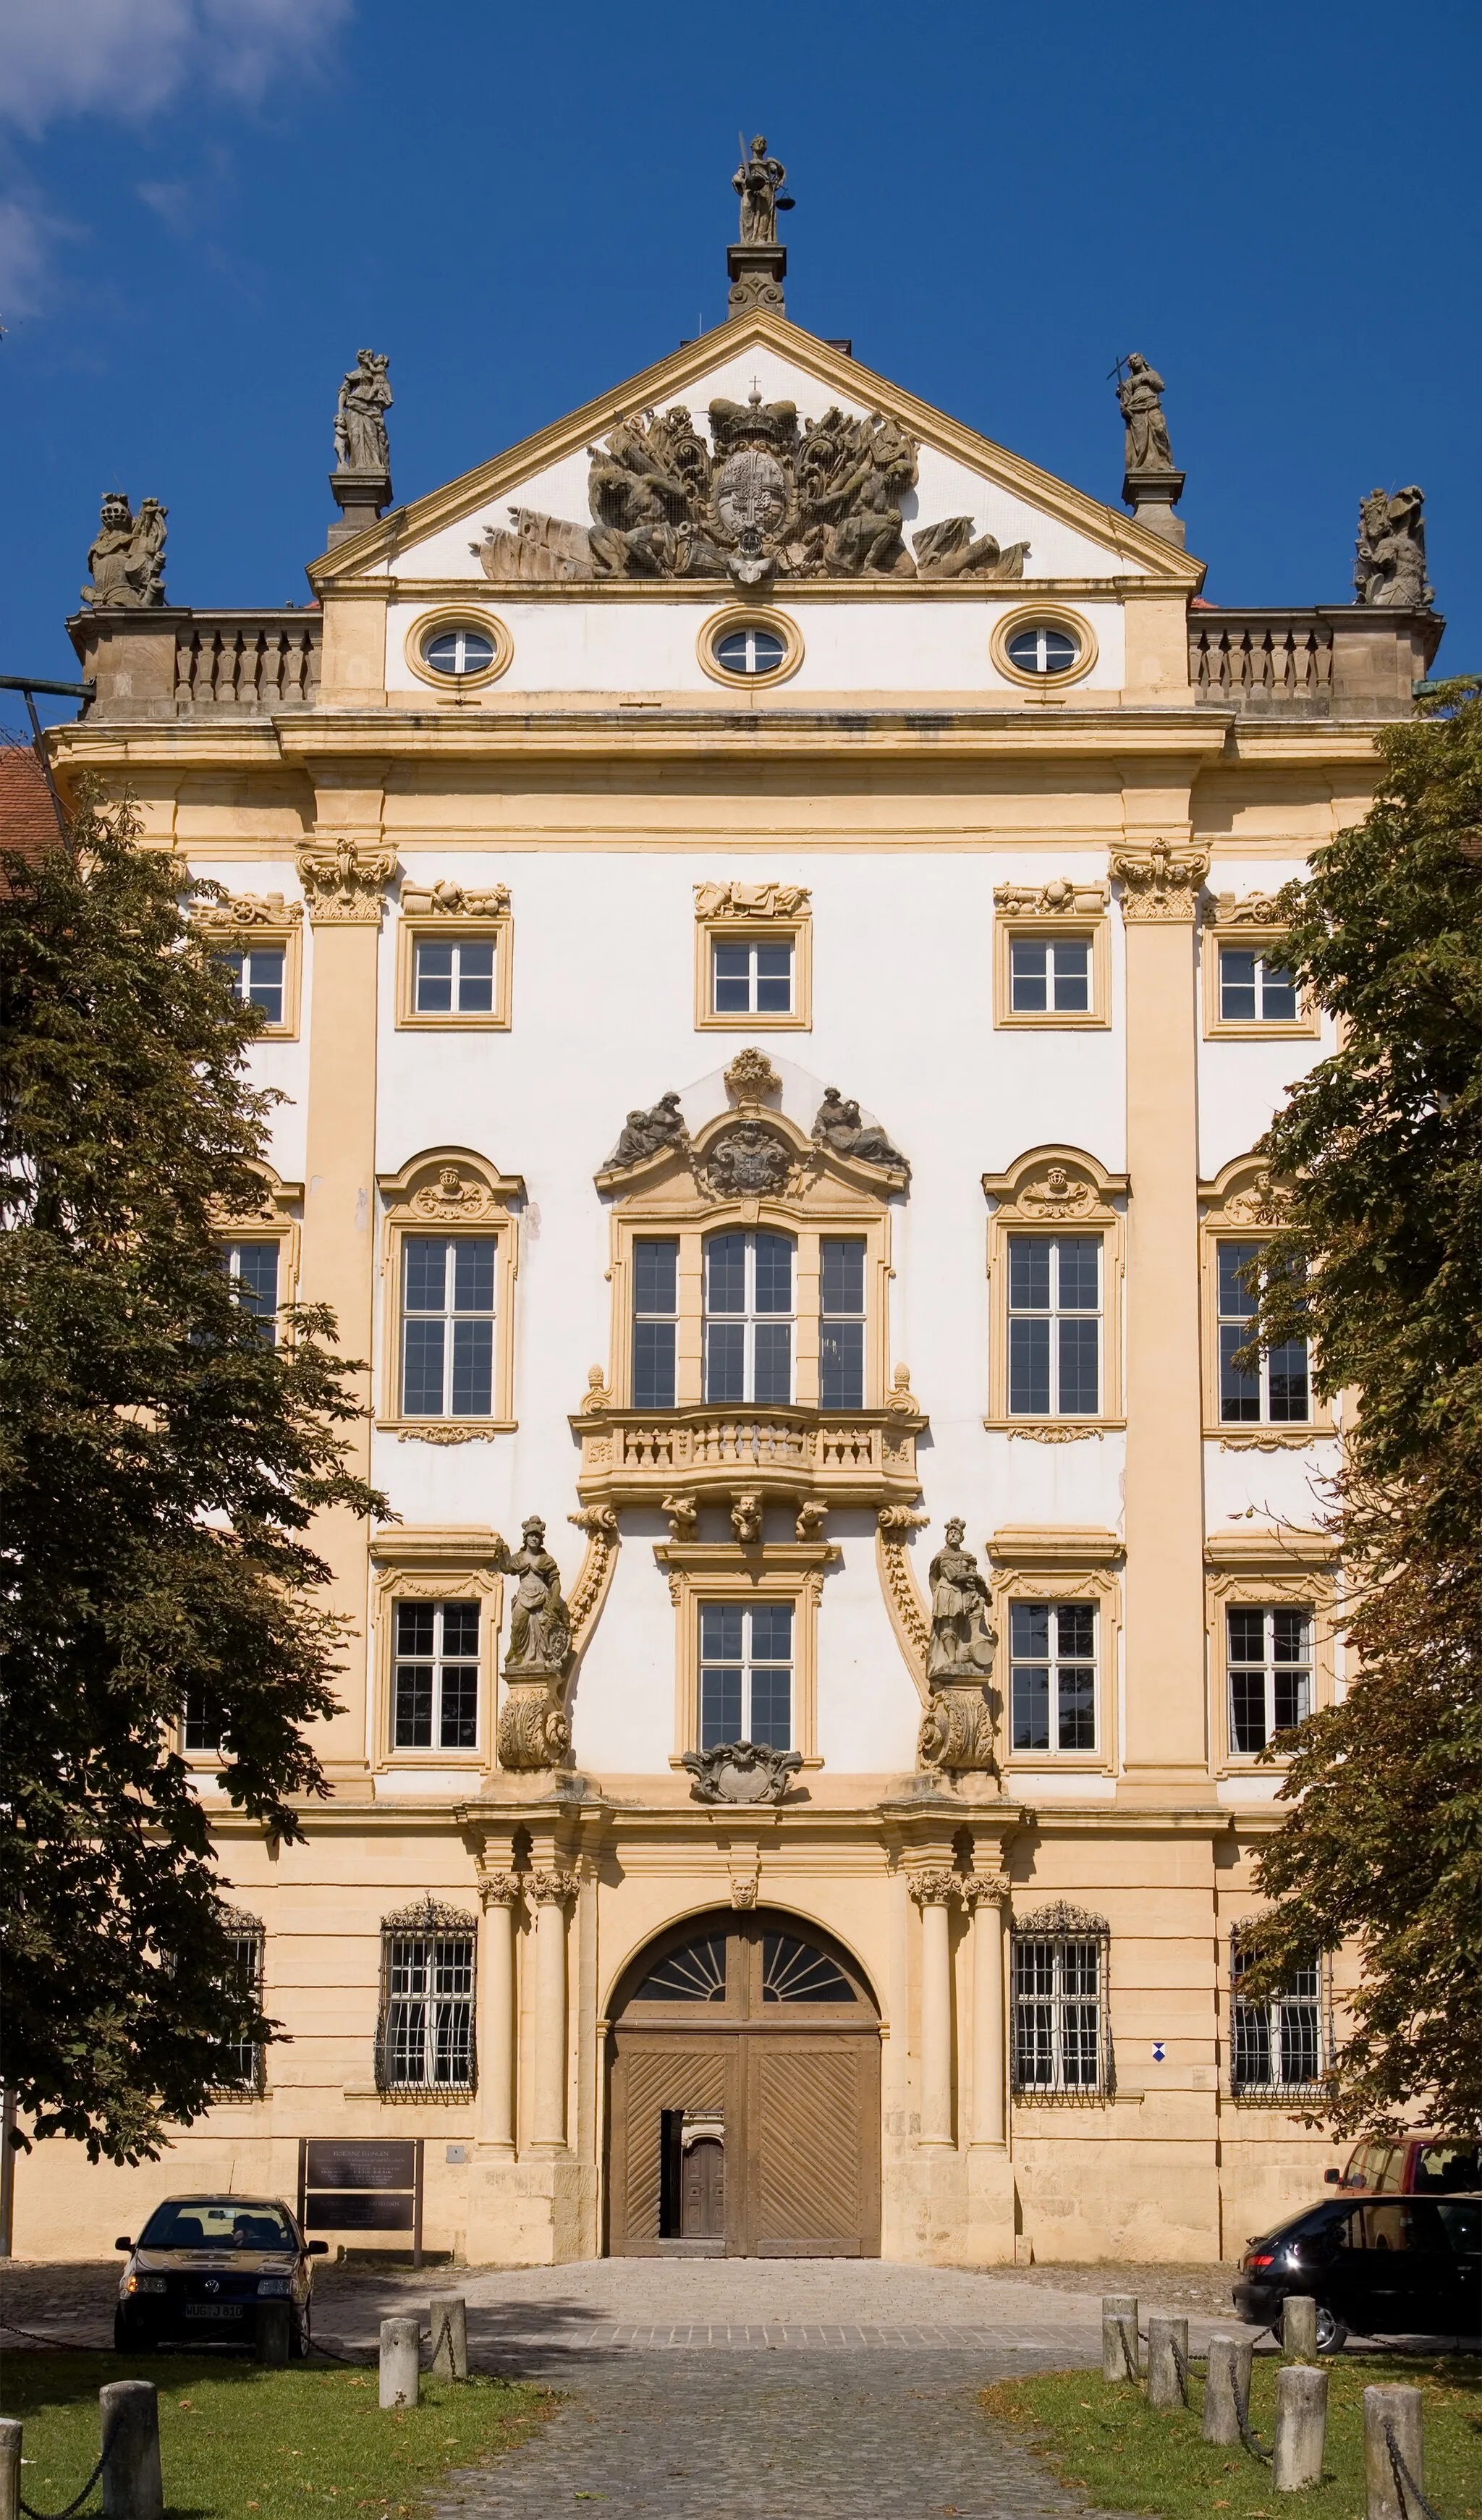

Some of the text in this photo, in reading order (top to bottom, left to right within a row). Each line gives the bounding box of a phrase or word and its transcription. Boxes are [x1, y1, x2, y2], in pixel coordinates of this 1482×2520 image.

[186, 2306, 242, 2317] WUG J 810
